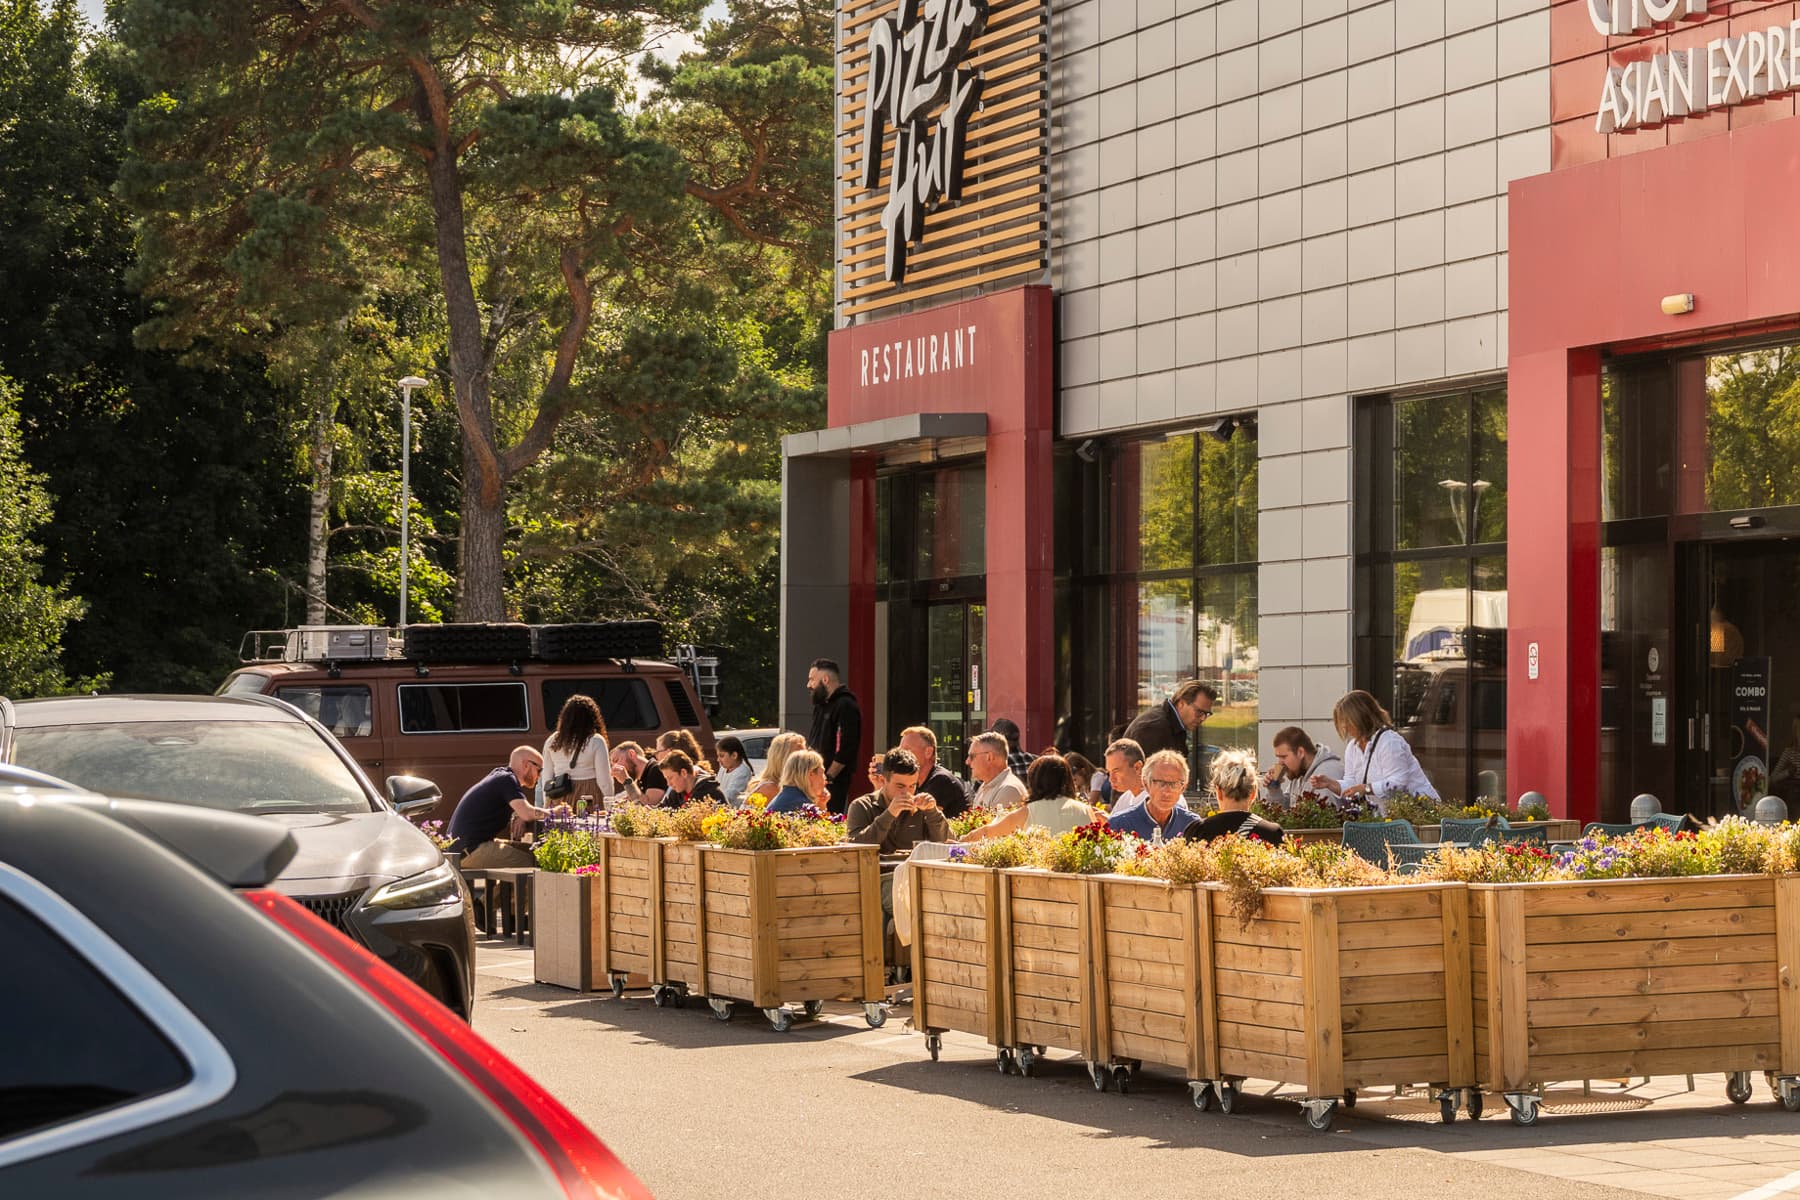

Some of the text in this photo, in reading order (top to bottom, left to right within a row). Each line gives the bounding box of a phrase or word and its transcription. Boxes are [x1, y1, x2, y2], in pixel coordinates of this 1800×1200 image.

[1595, 46, 1707, 134] ASIAN
[881, 68, 978, 282] Hut
[860, 325, 977, 387] RESTAURANT
[1735, 686, 1766, 697] COMBO
